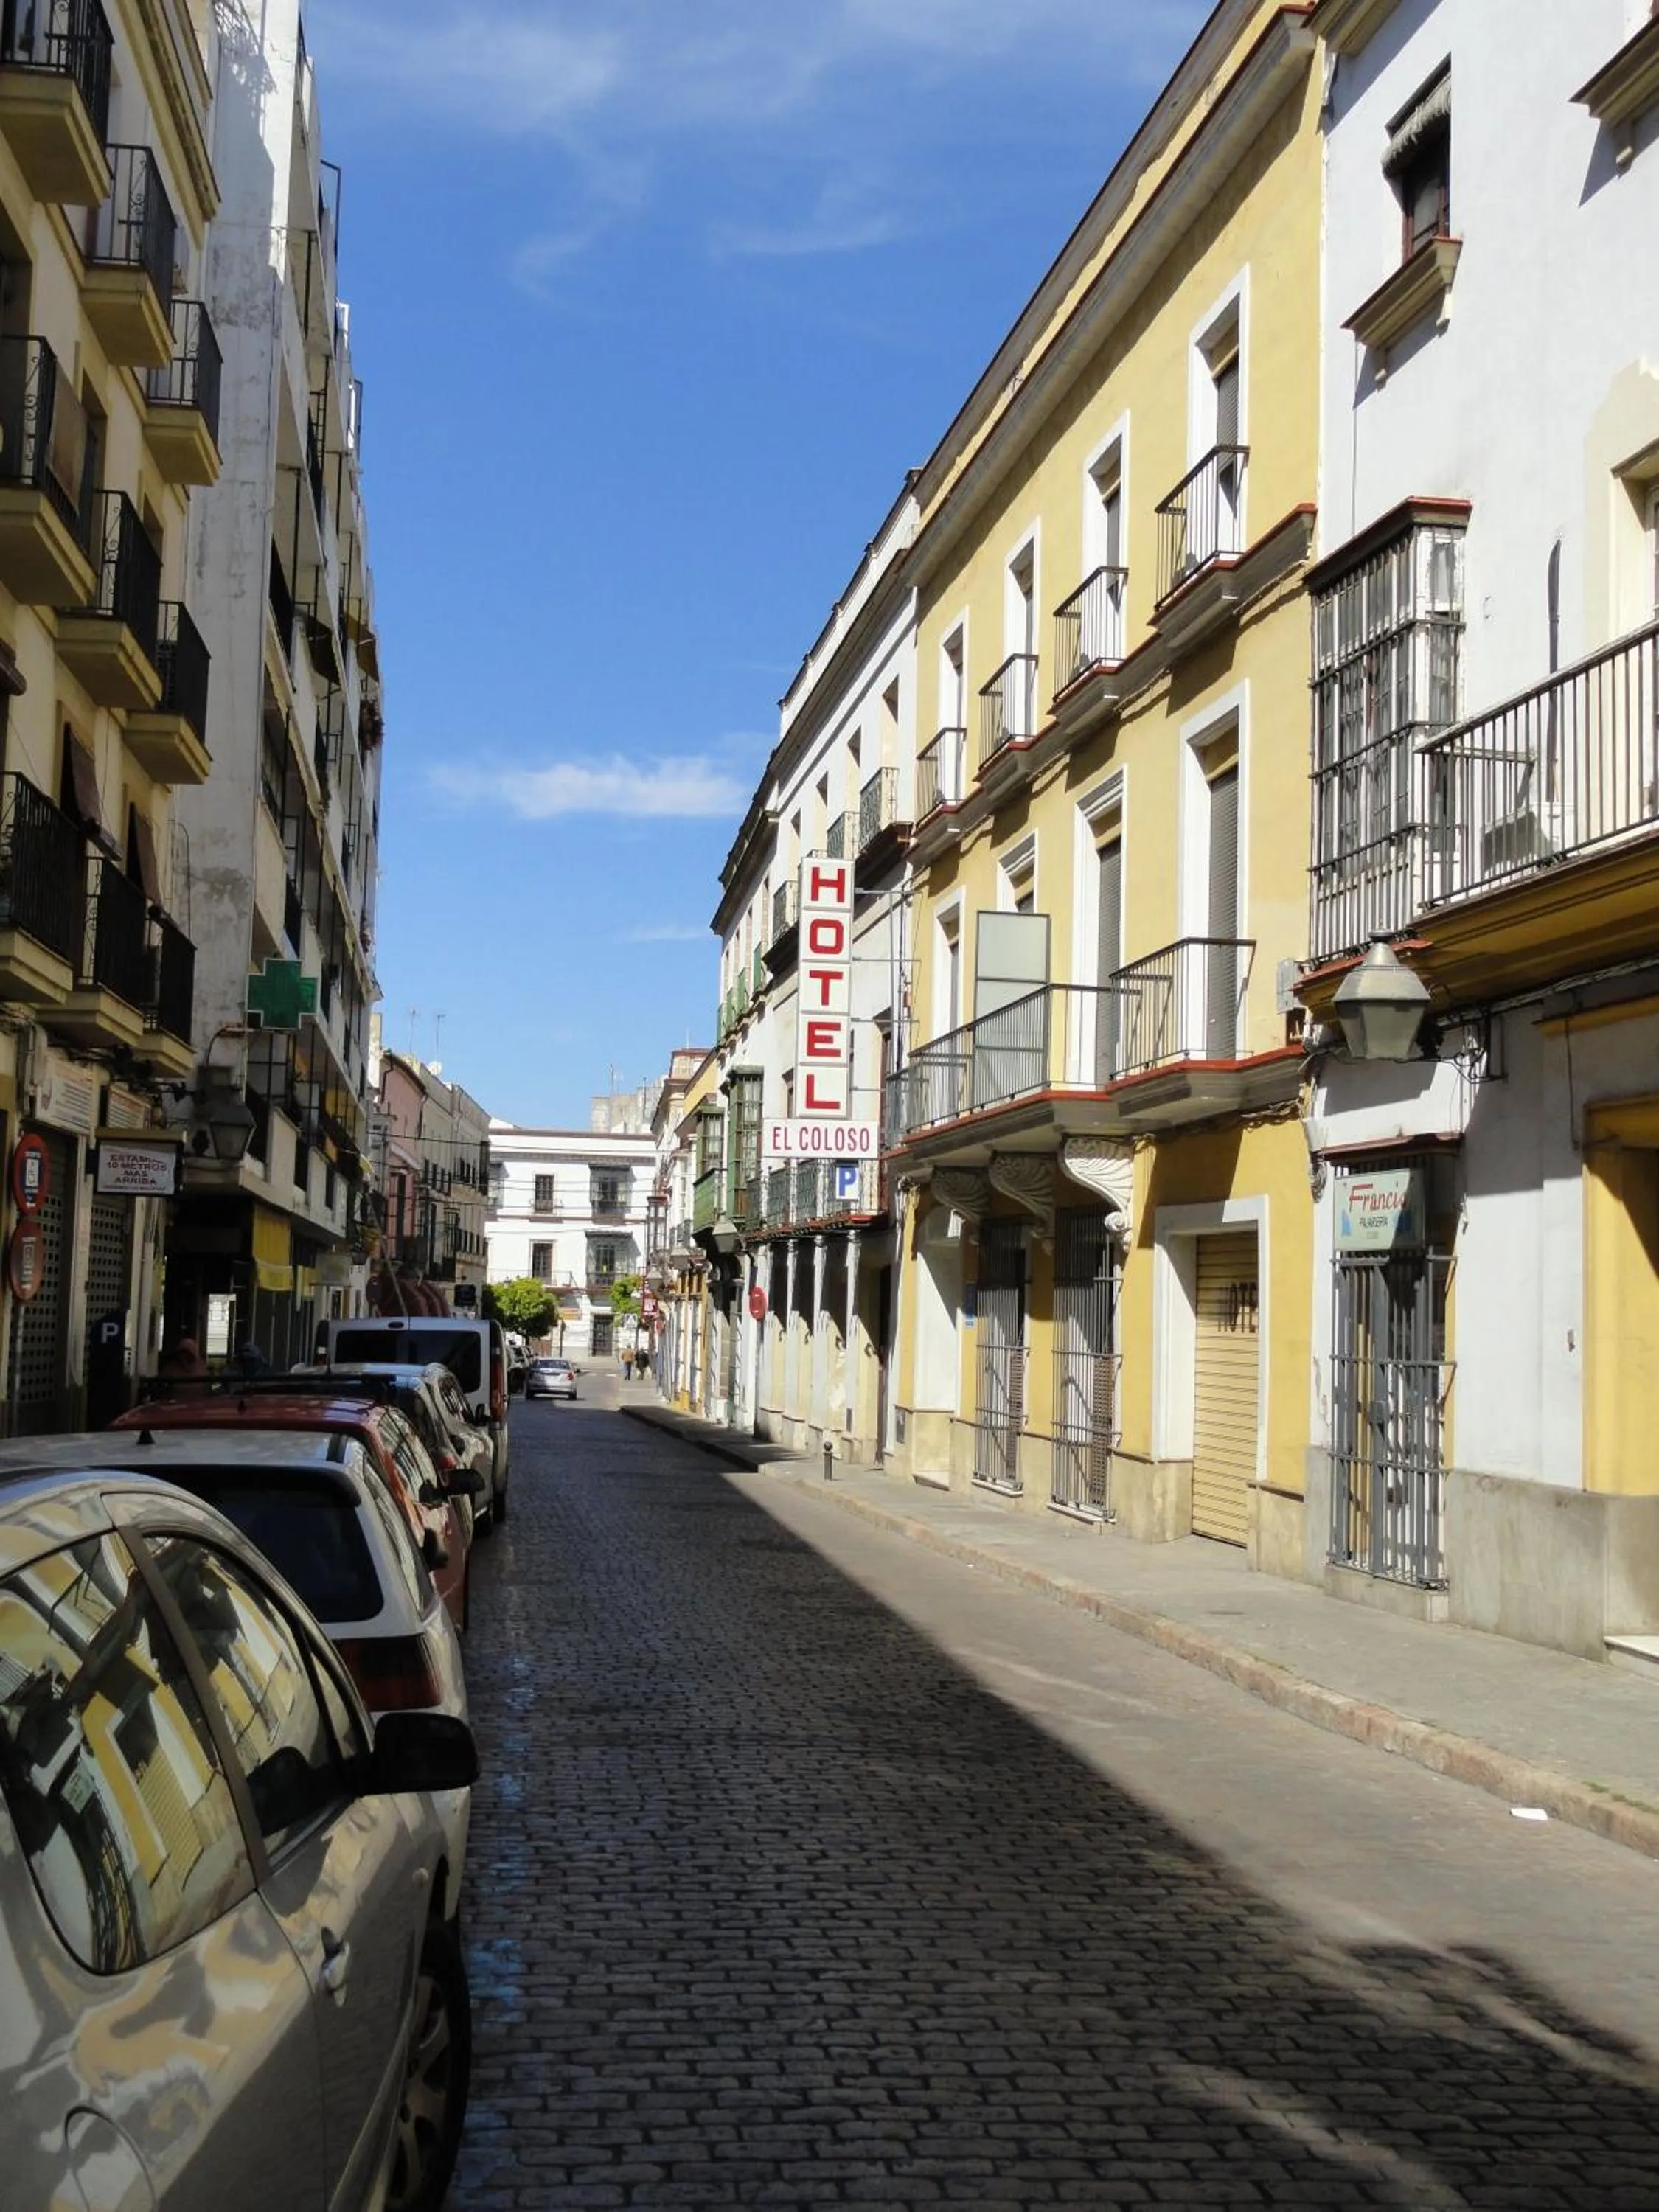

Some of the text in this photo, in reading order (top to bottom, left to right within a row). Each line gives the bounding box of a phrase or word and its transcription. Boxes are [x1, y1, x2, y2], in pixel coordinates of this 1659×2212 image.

[806, 866, 846, 1110] HOTEL
[773, 1126, 869, 1152] EL COLOSO
[121, 1163, 167, 1172] METROS
[114, 1177, 157, 1185] ARRIBA
[838, 1167, 857, 1196] P
[102, 1322, 119, 1343] P
